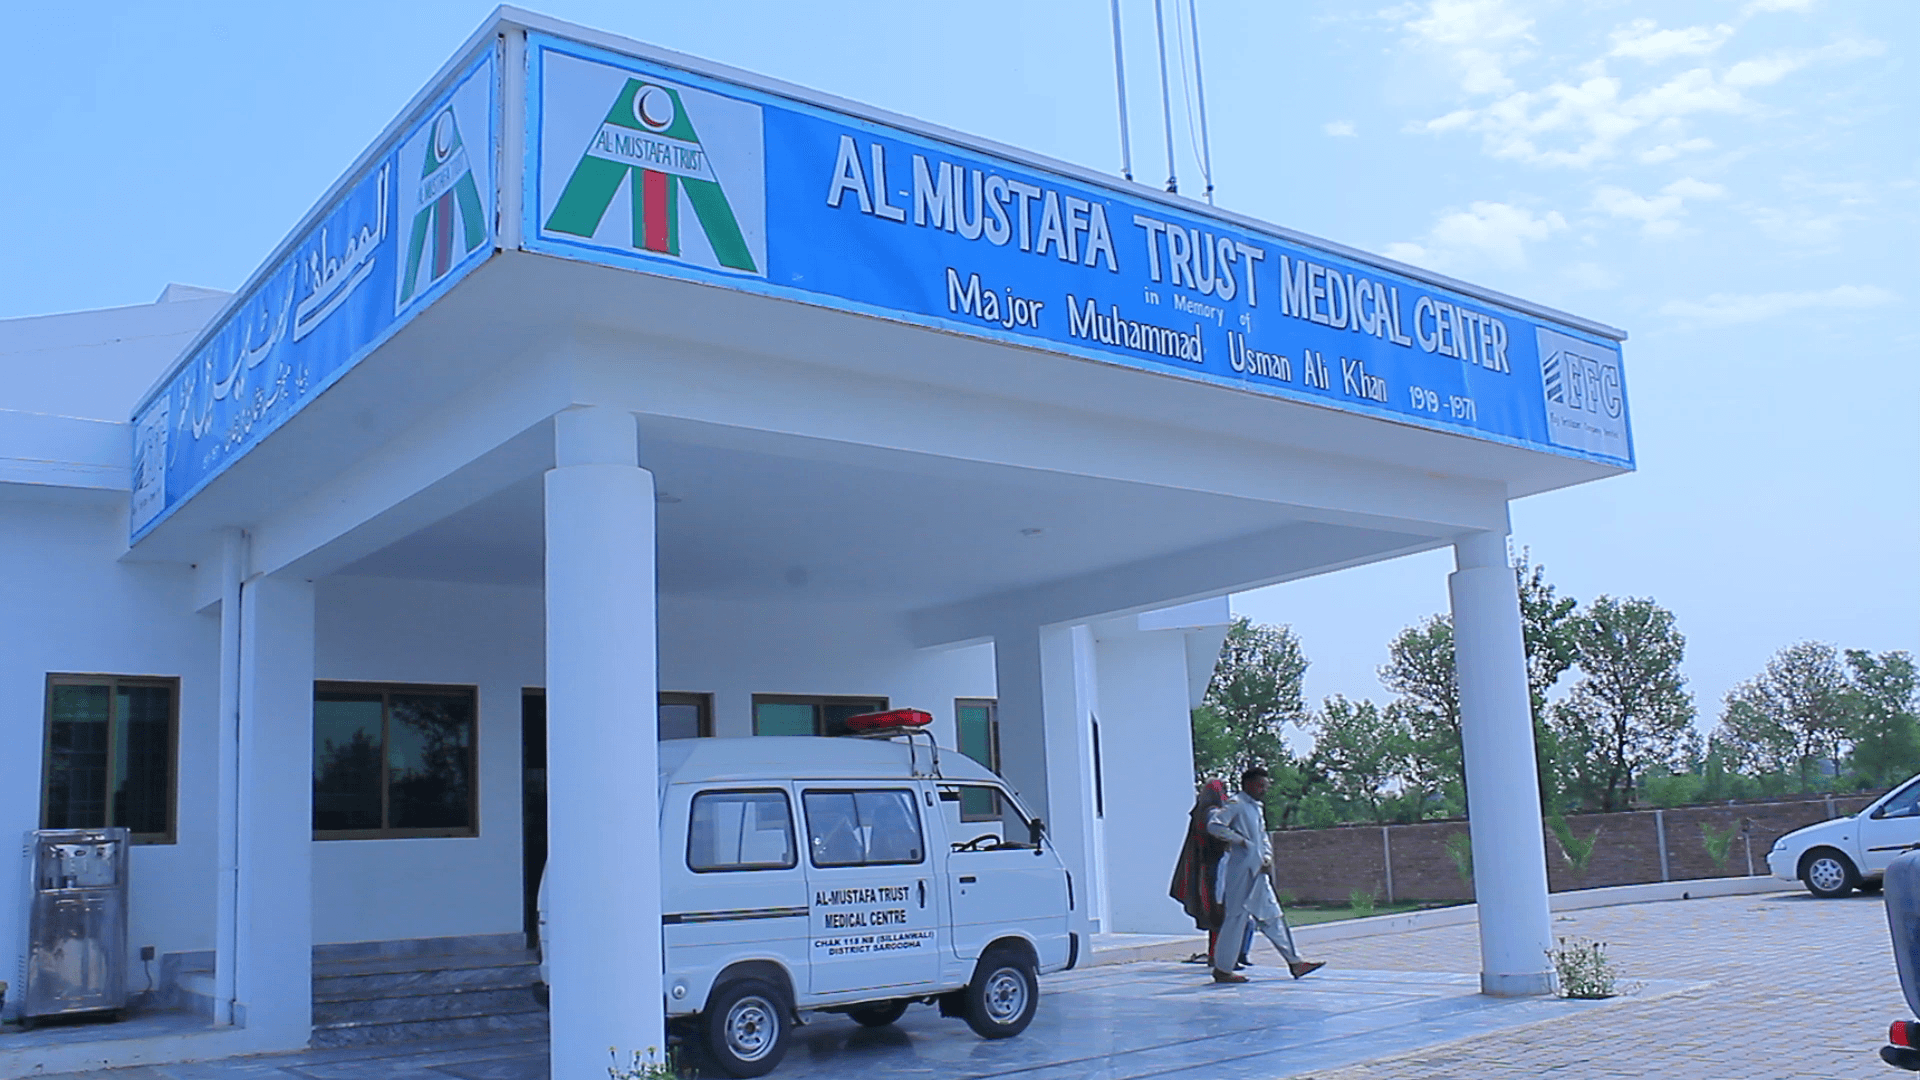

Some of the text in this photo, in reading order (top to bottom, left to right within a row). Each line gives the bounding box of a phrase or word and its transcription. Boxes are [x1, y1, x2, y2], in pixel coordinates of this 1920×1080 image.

[673, 145, 703, 171] TRUST
[826, 134, 1511, 374] AL-MUSTAFA TRUST MEDICAL CENTER
[1144, 286, 1251, 334] in Memory of
[946, 267, 1044, 329] Major
[1066, 293, 1204, 364] Muhammad
[1227, 330, 1293, 382] Usman
[1304, 348, 1330, 391] Ali
[1341, 357, 1388, 403] Khan
[815, 886, 909, 907] AL-MUSTAFA TRUST
[825, 909, 907, 929] MEDICAL CENTRE
[814, 938, 841, 948] CHAK
[828, 945, 870, 956] DISTRICT
